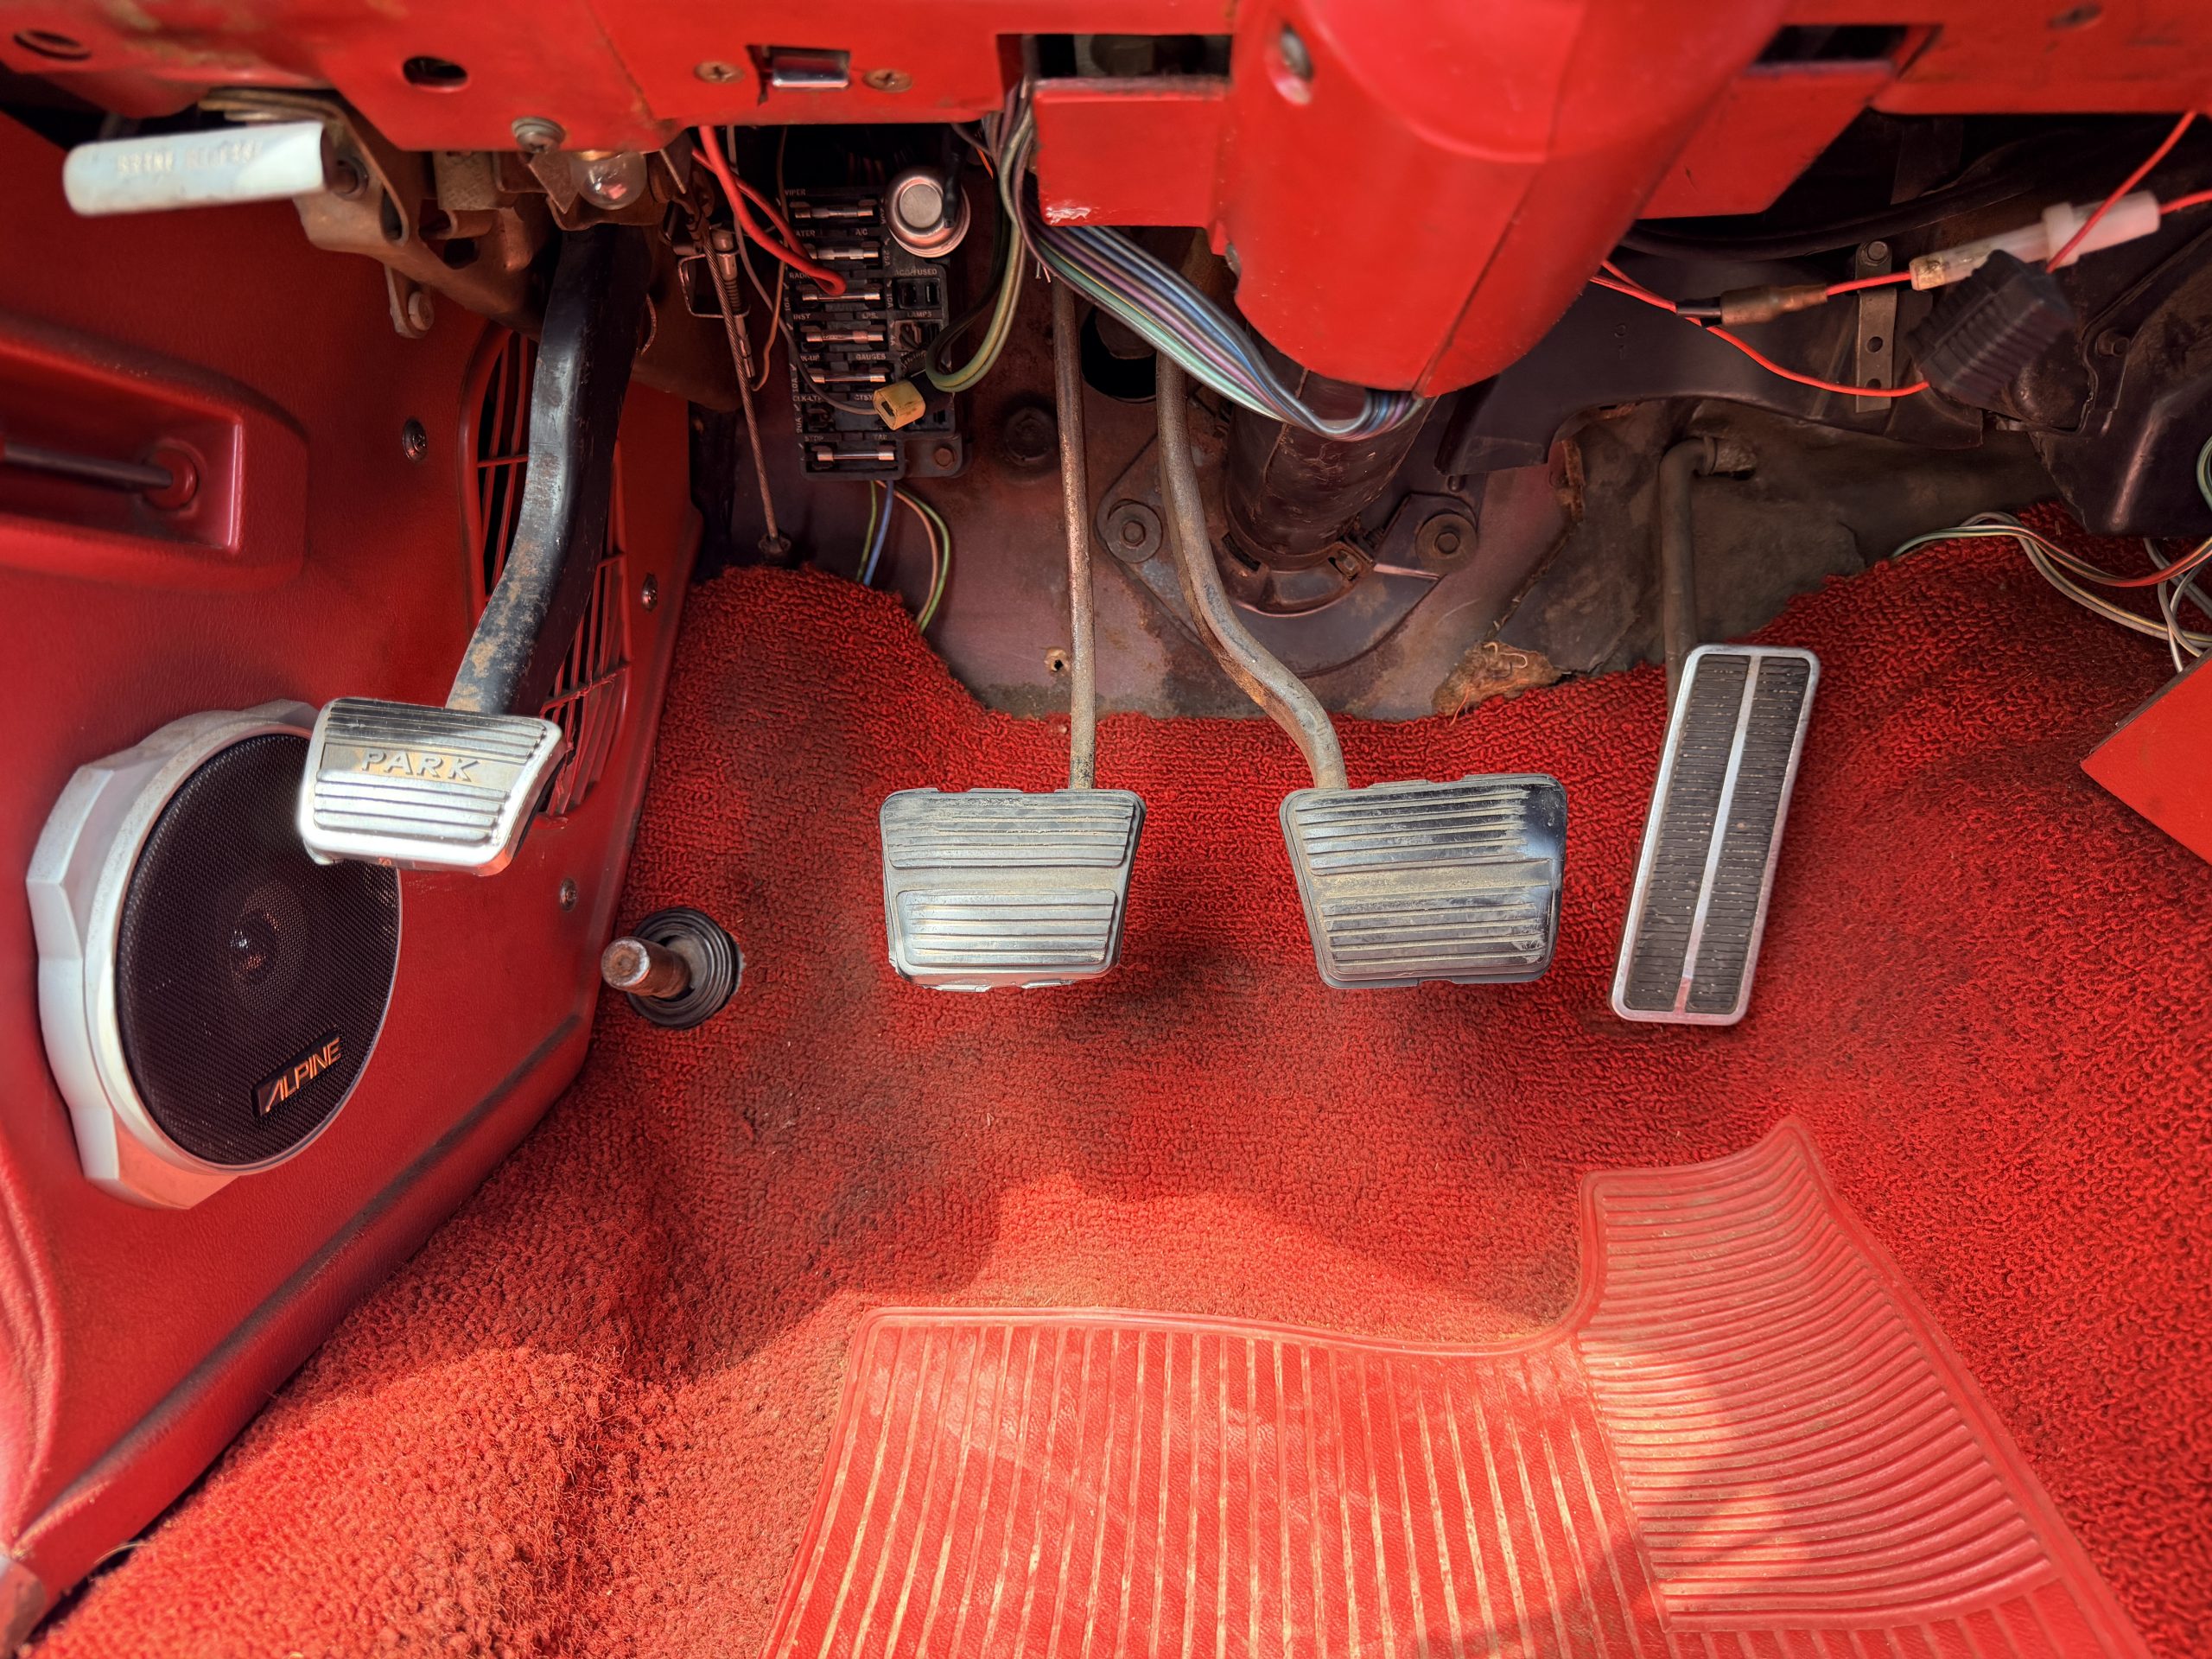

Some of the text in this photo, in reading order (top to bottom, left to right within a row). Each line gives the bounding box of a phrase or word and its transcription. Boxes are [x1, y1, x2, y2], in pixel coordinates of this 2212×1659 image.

[791, 378, 799, 393] 10A
[361, 749, 479, 782] PARK
[265, 1037, 342, 1113] ALPINE
